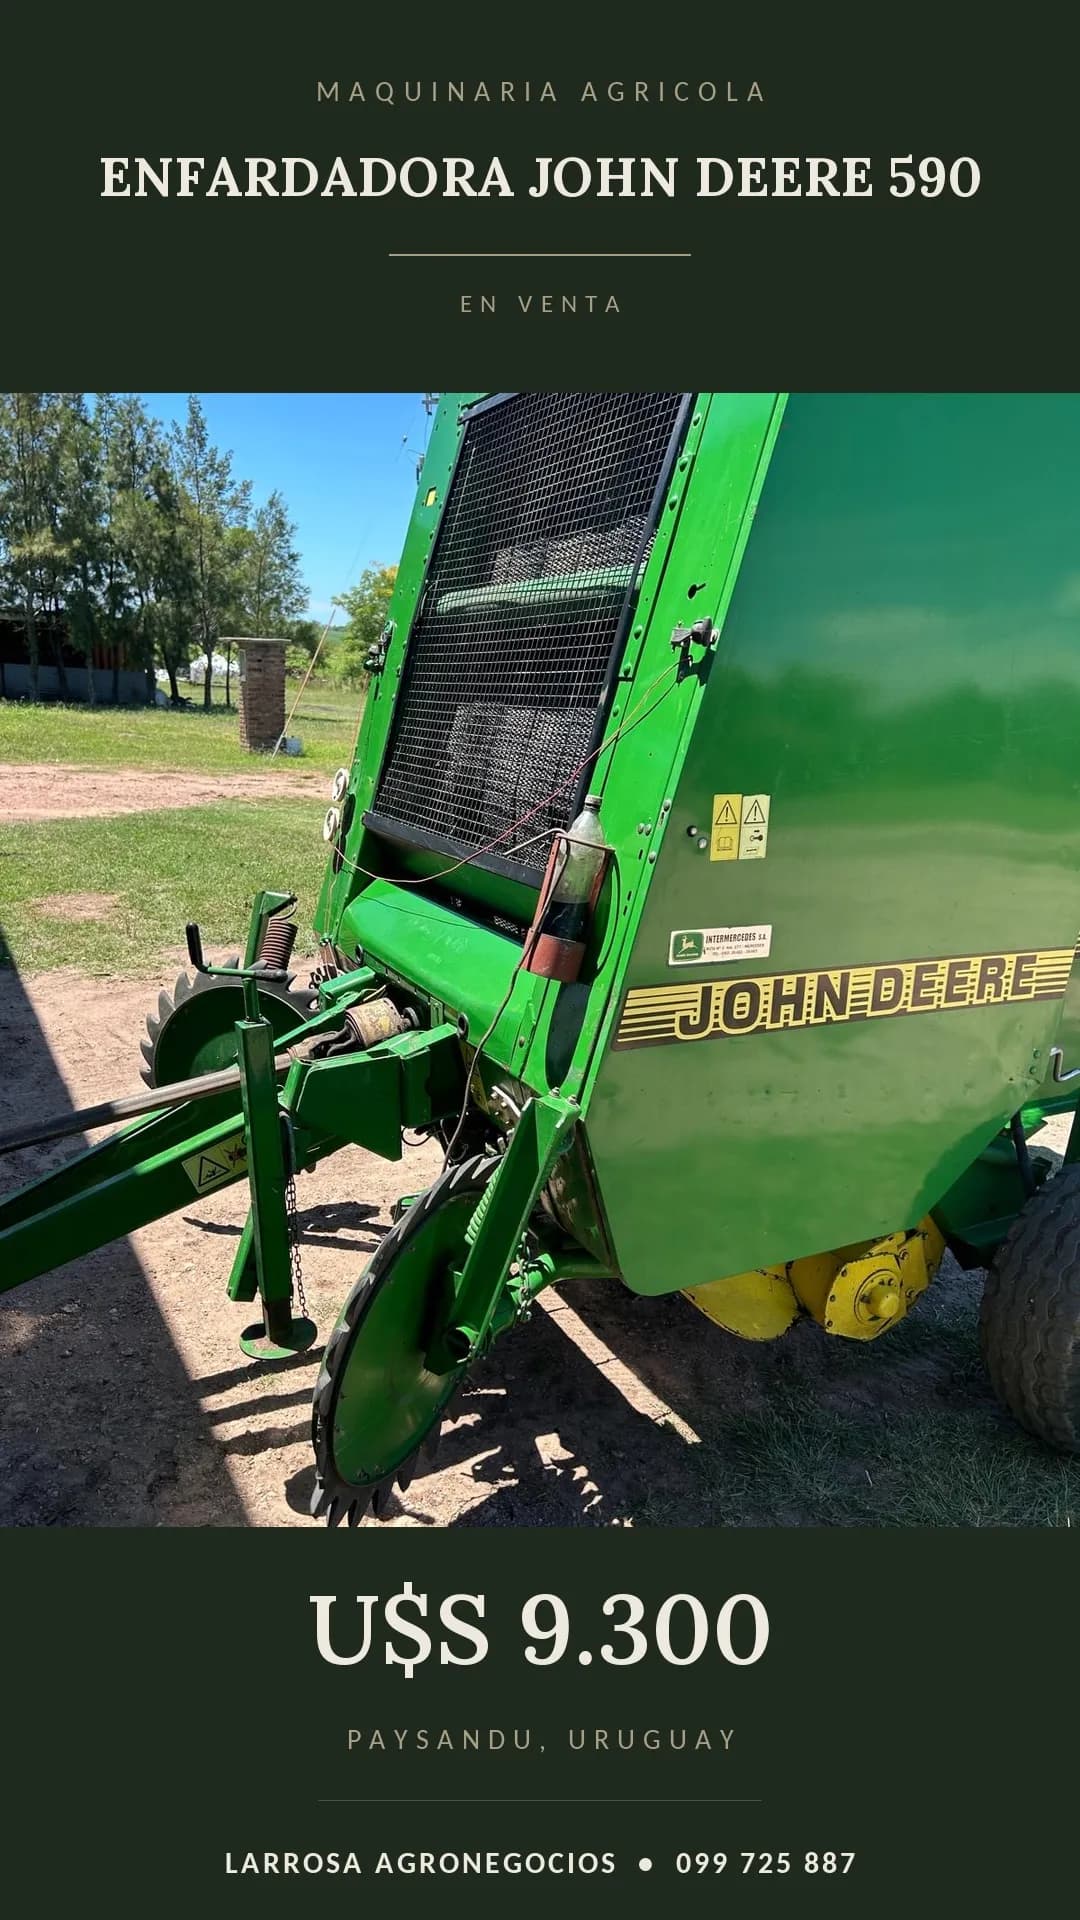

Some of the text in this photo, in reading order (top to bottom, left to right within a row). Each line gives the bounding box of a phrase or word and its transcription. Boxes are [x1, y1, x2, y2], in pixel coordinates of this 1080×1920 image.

[705, 932, 757, 944] INTERMERCEDES
[676, 954, 1038, 1039] JOHN DEERE
